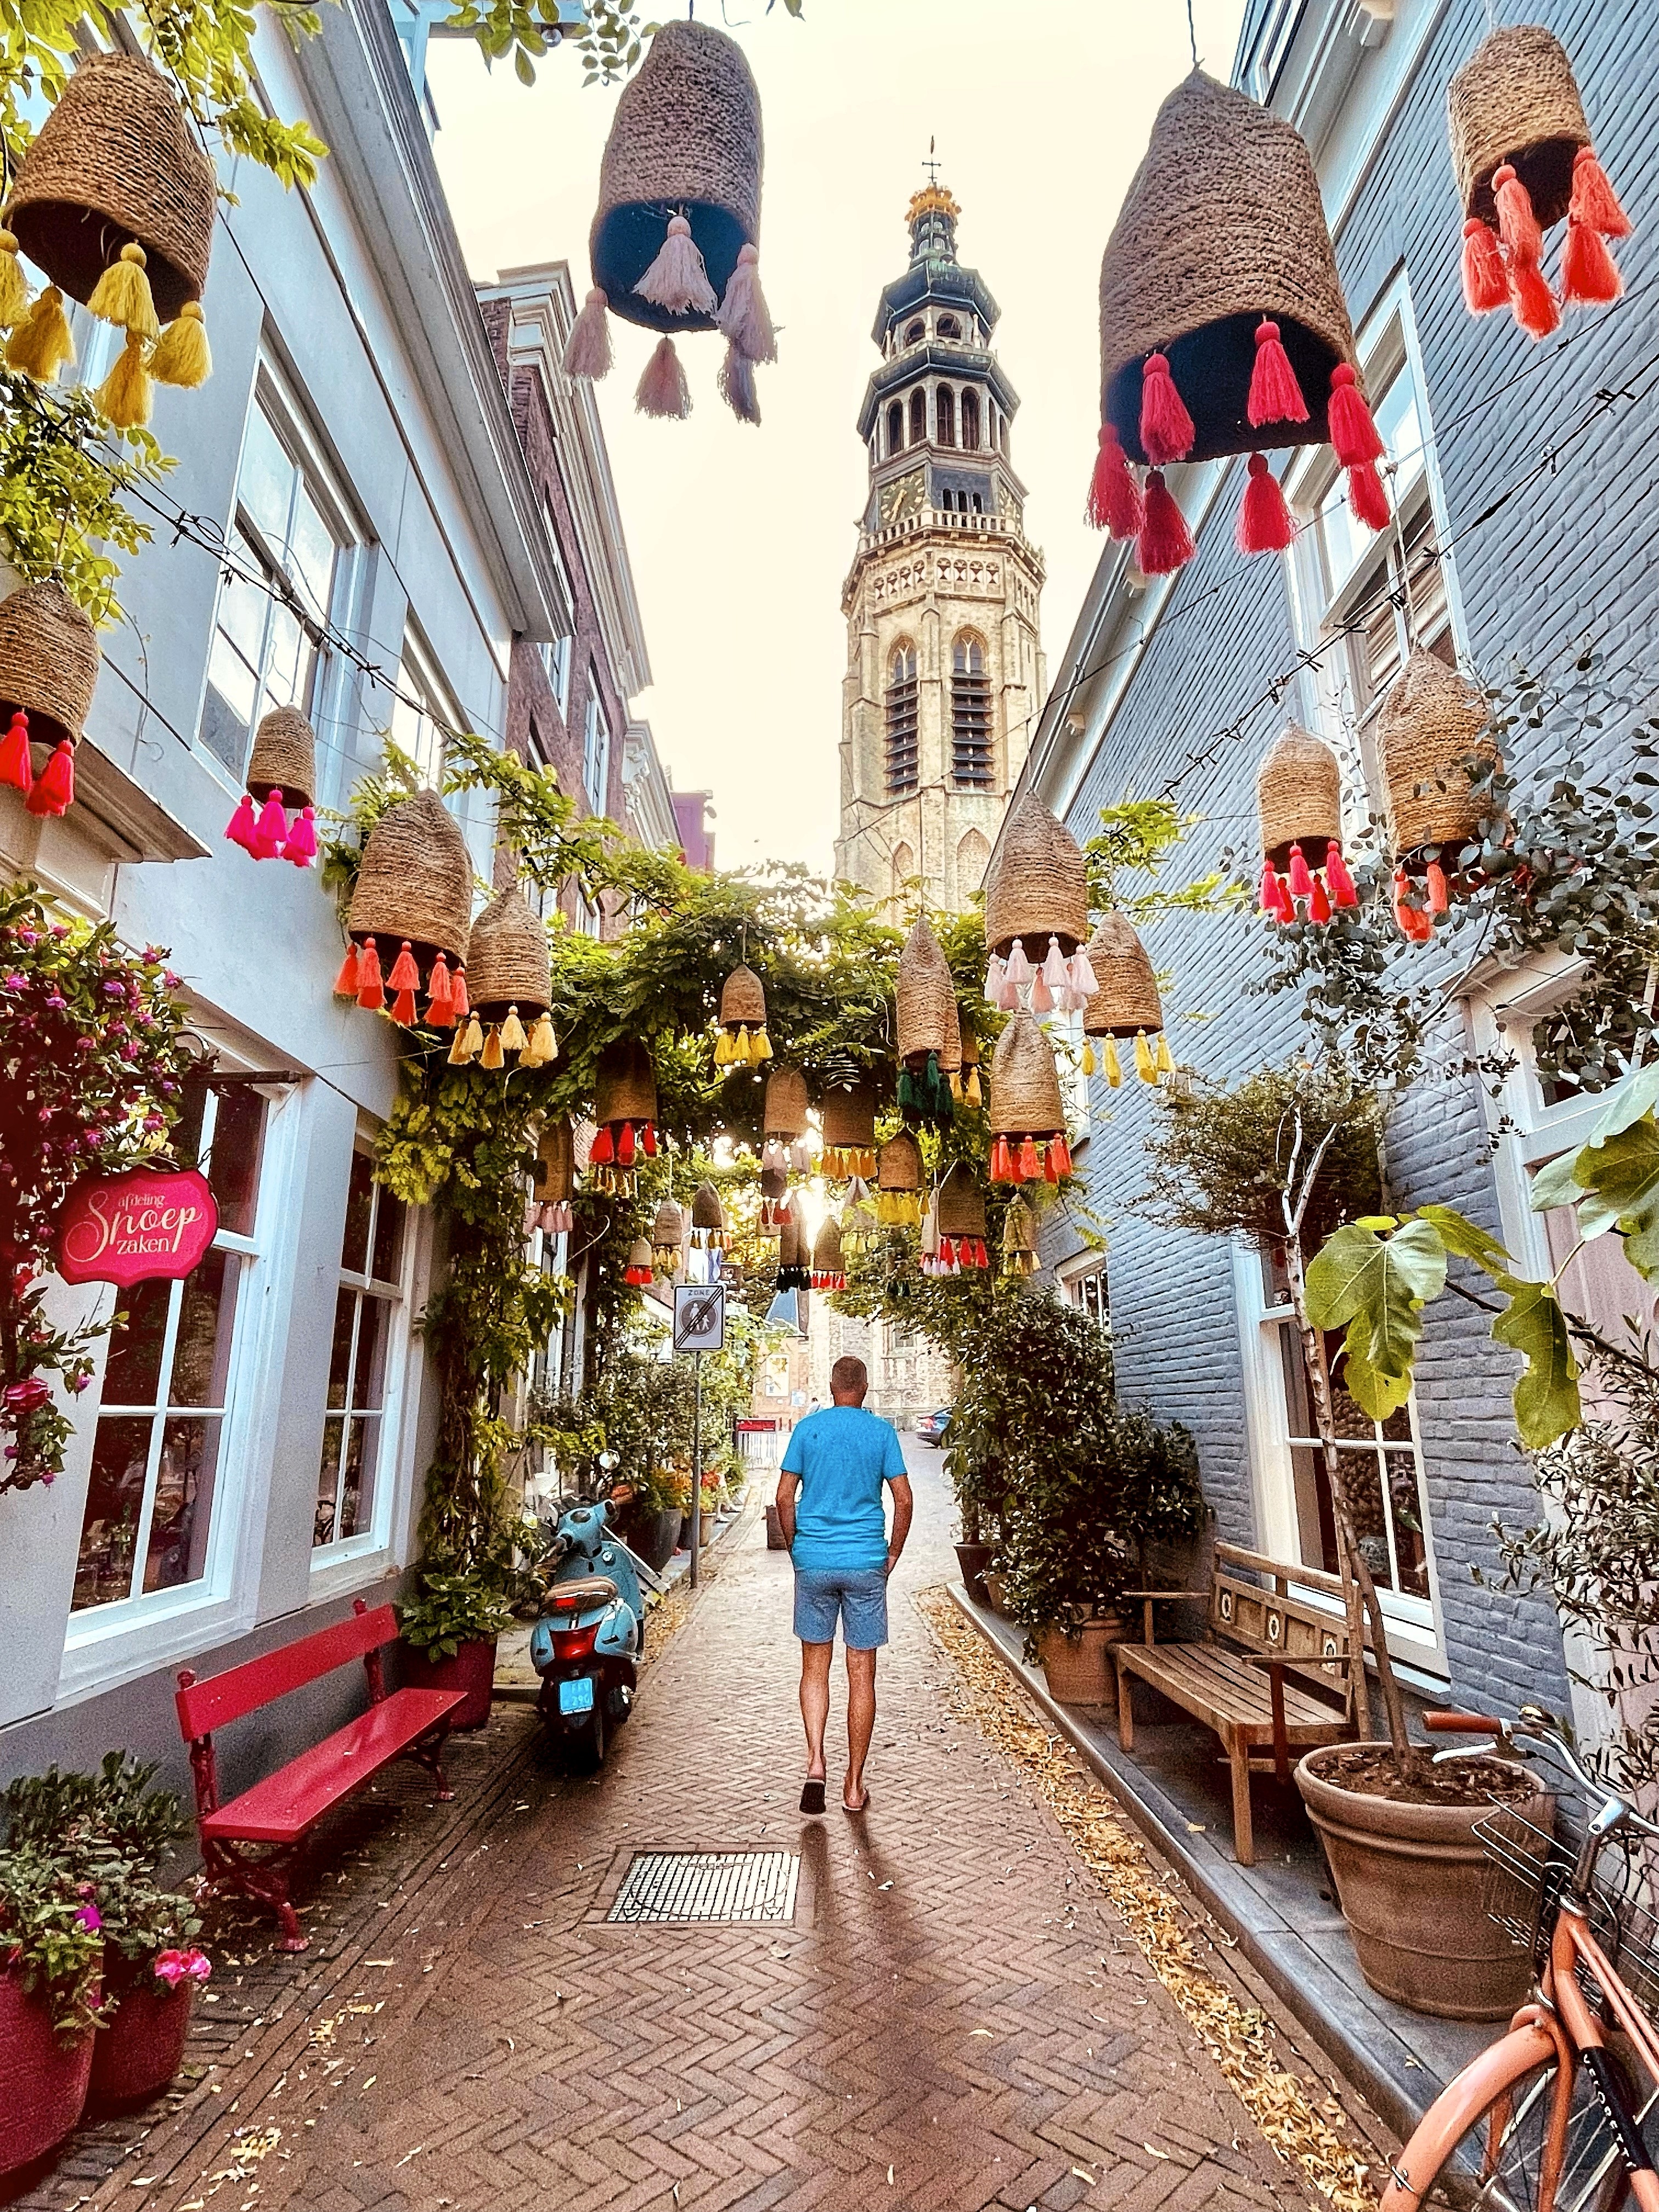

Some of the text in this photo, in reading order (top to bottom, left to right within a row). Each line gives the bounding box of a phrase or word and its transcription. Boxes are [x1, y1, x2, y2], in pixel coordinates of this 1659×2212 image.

[119, 1193, 165, 1211] afdeling
[66, 1190, 203, 1263] Snoep
[117, 1234, 170, 1255] zaken
